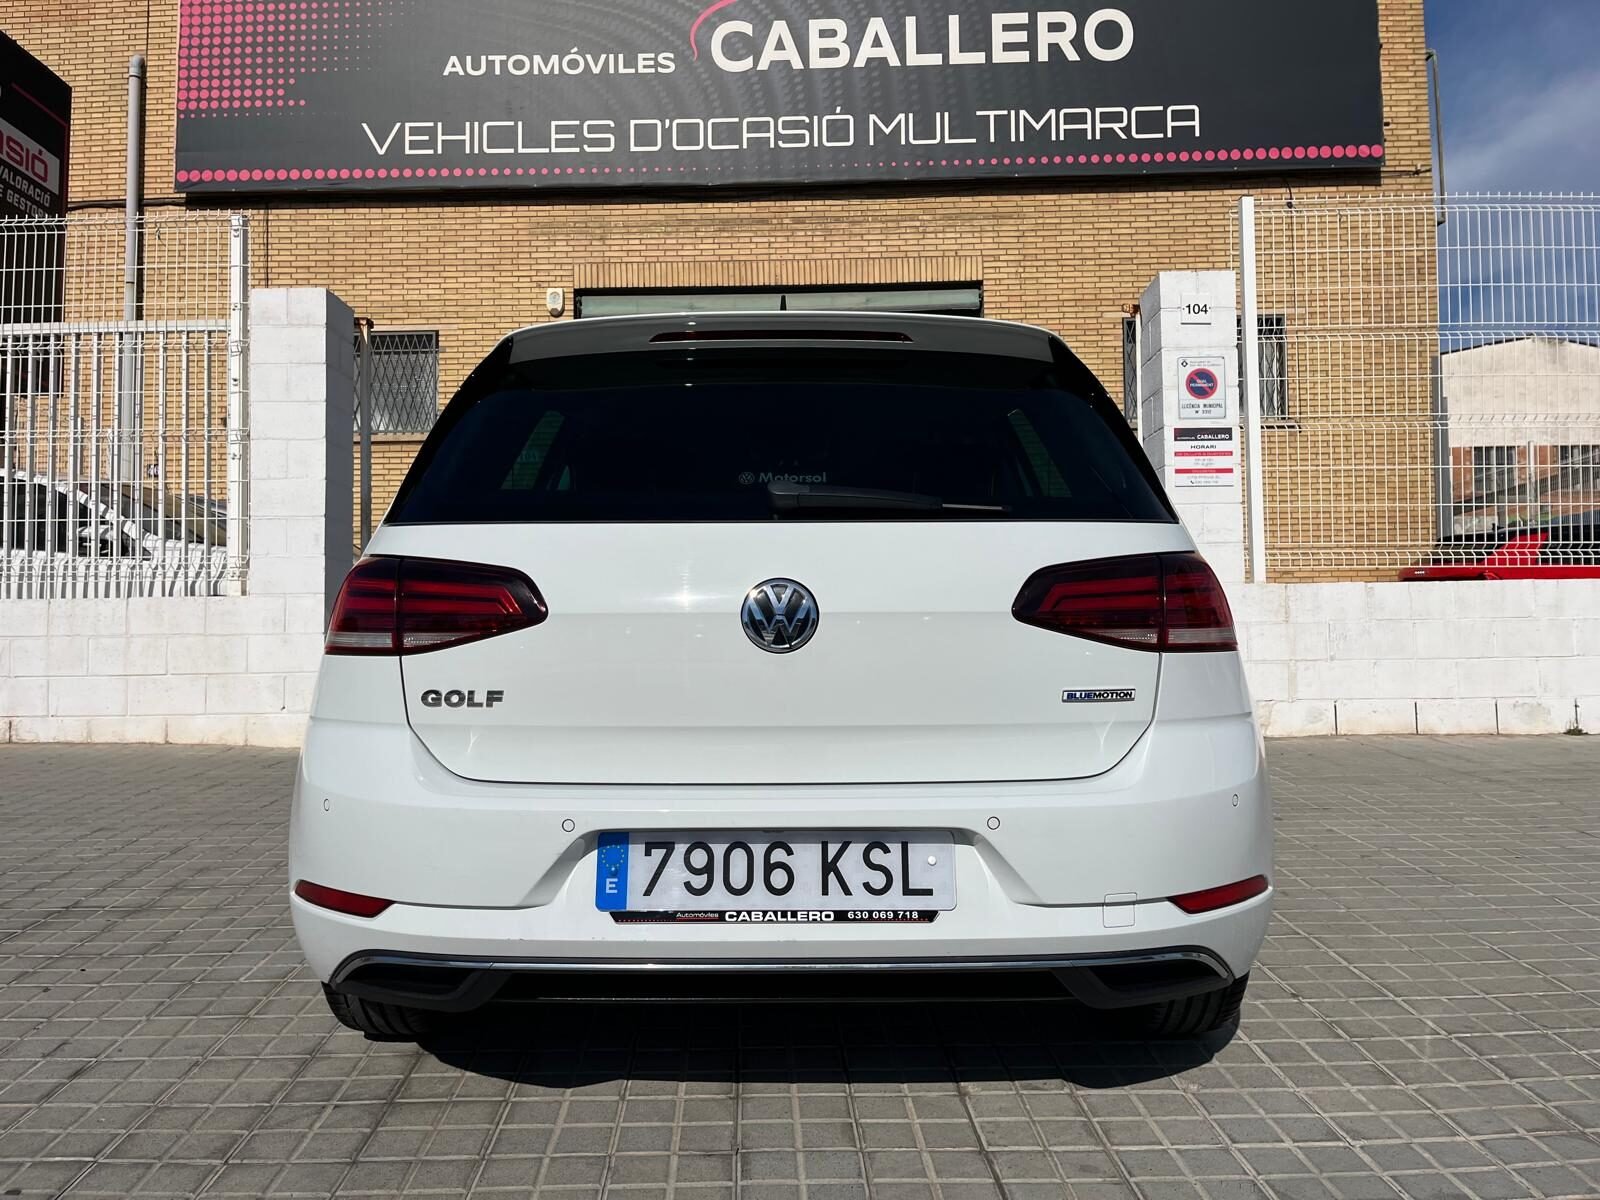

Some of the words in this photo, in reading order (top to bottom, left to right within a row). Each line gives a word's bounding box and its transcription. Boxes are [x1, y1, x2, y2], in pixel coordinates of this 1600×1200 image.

[443, 47, 676, 76] AUTOMÓVILES
[710, 8, 1134, 72] CABALLERO
[361, 119, 615, 155] VEHICLES
[629, 106, 854, 153] D'OCASIÓ
[869, 104, 1200, 146] MULTIMARCA
[0, 129, 48, 183] SIÓ
[1185, 304, 1209, 315] 104
[759, 471, 827, 484] Motorsol
[421, 689, 504, 708] GOLF
[1066, 691, 1133, 700] BLUEMOTION
[642, 841, 795, 897] 7906
[821, 840, 934, 897] KSL
[605, 878, 618, 894] E
[724, 911, 835, 922] CABALLERO
[847, 911, 868, 919] 630
[872, 911, 894, 919] 069
[898, 911, 919, 919] 718
